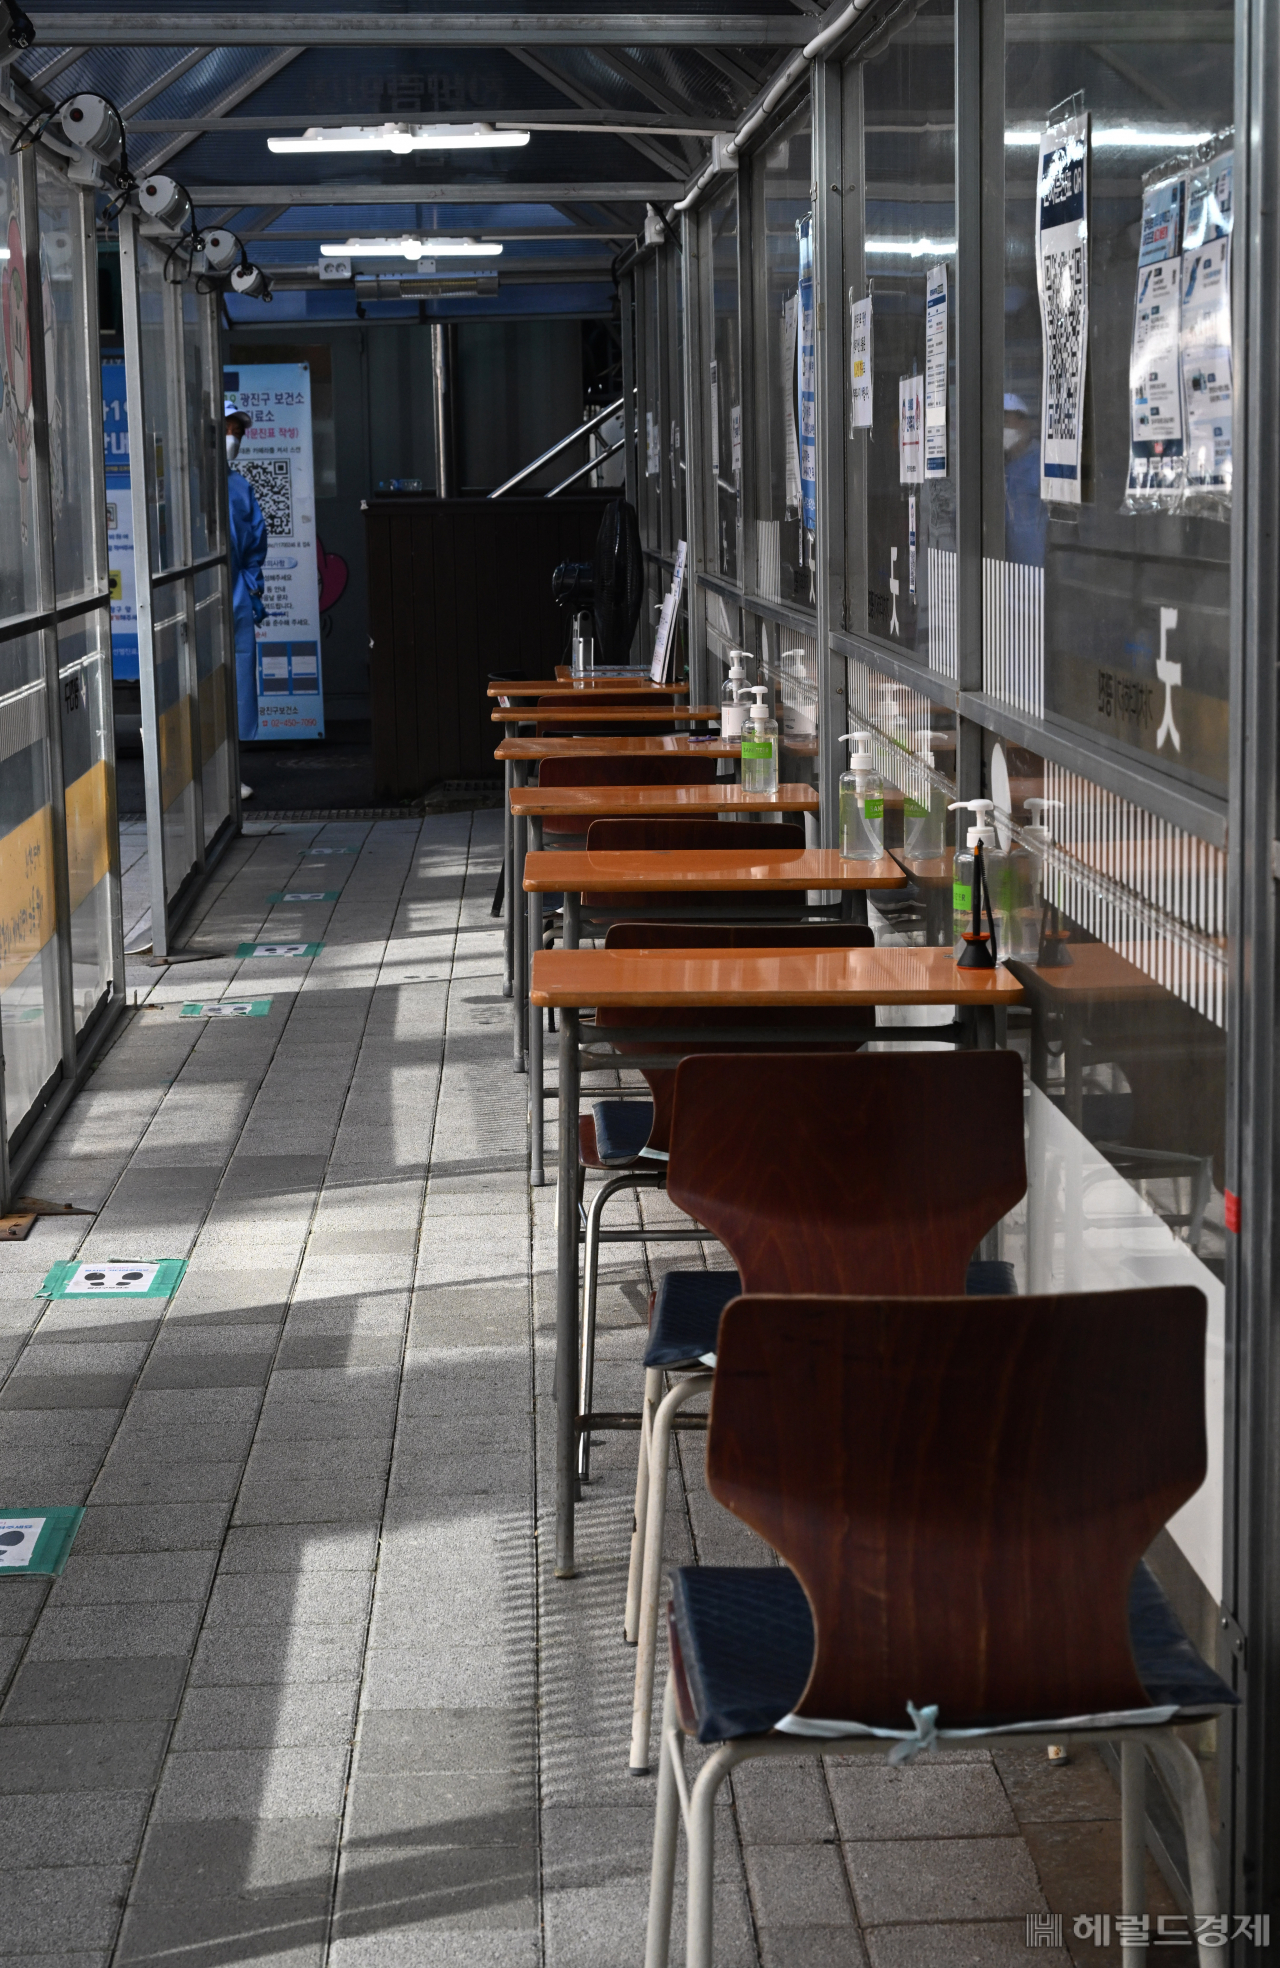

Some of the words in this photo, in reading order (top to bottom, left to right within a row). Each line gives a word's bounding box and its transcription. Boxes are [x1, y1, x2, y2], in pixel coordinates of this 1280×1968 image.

[1074, 166, 1083, 194] QR
[240, 393, 271, 407] 광진구
[274, 392, 305, 406] 보건소
[279, 427, 299, 439] 작성)
[273, 619, 290, 627] 준수해
[292, 618, 311, 627] 주세요.
[259, 706, 299, 717] 광진구보건소
[271, 718, 317, 728] 02-450-7090
